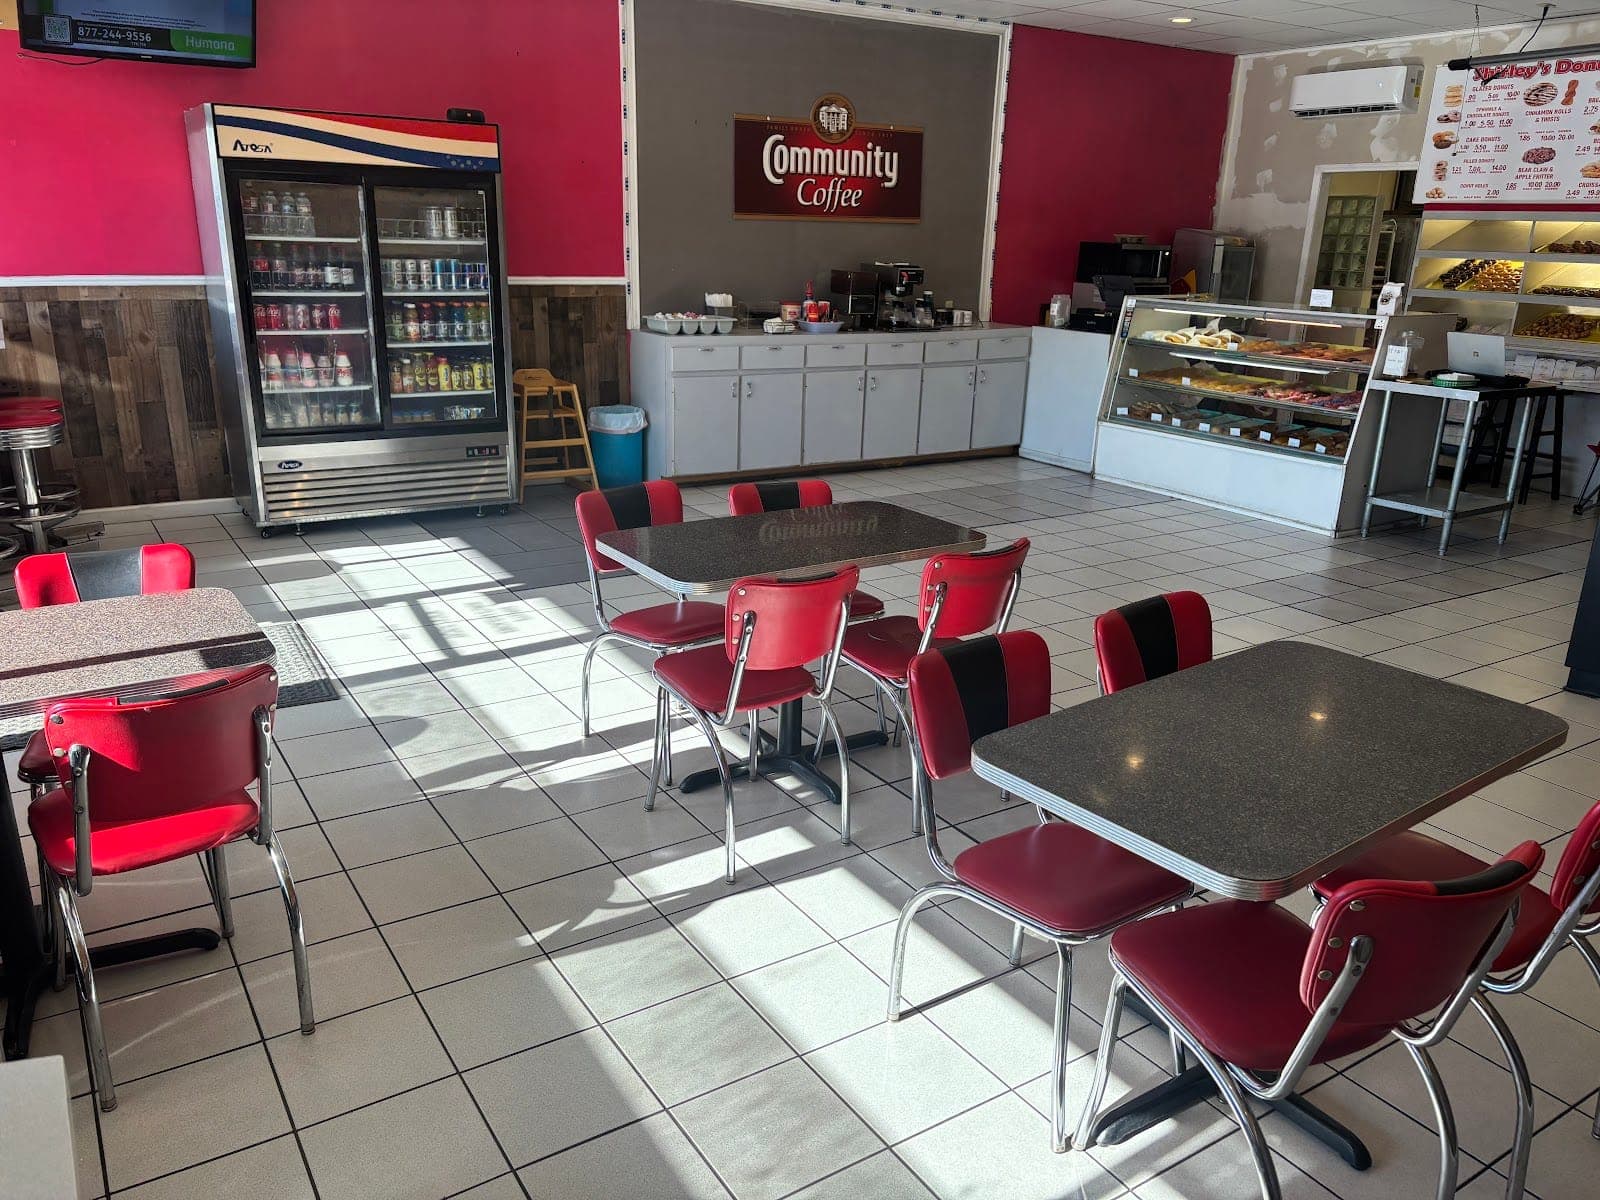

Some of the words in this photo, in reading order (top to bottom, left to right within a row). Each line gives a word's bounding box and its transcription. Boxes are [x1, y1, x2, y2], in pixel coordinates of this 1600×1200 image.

[78, 26, 152, 42] 877-244-9556
[185, 35, 235, 51] Humana
[1493, 83, 1514, 91] DONUTS
[762, 134, 899, 188] Community
[797, 177, 863, 213] Coffee
